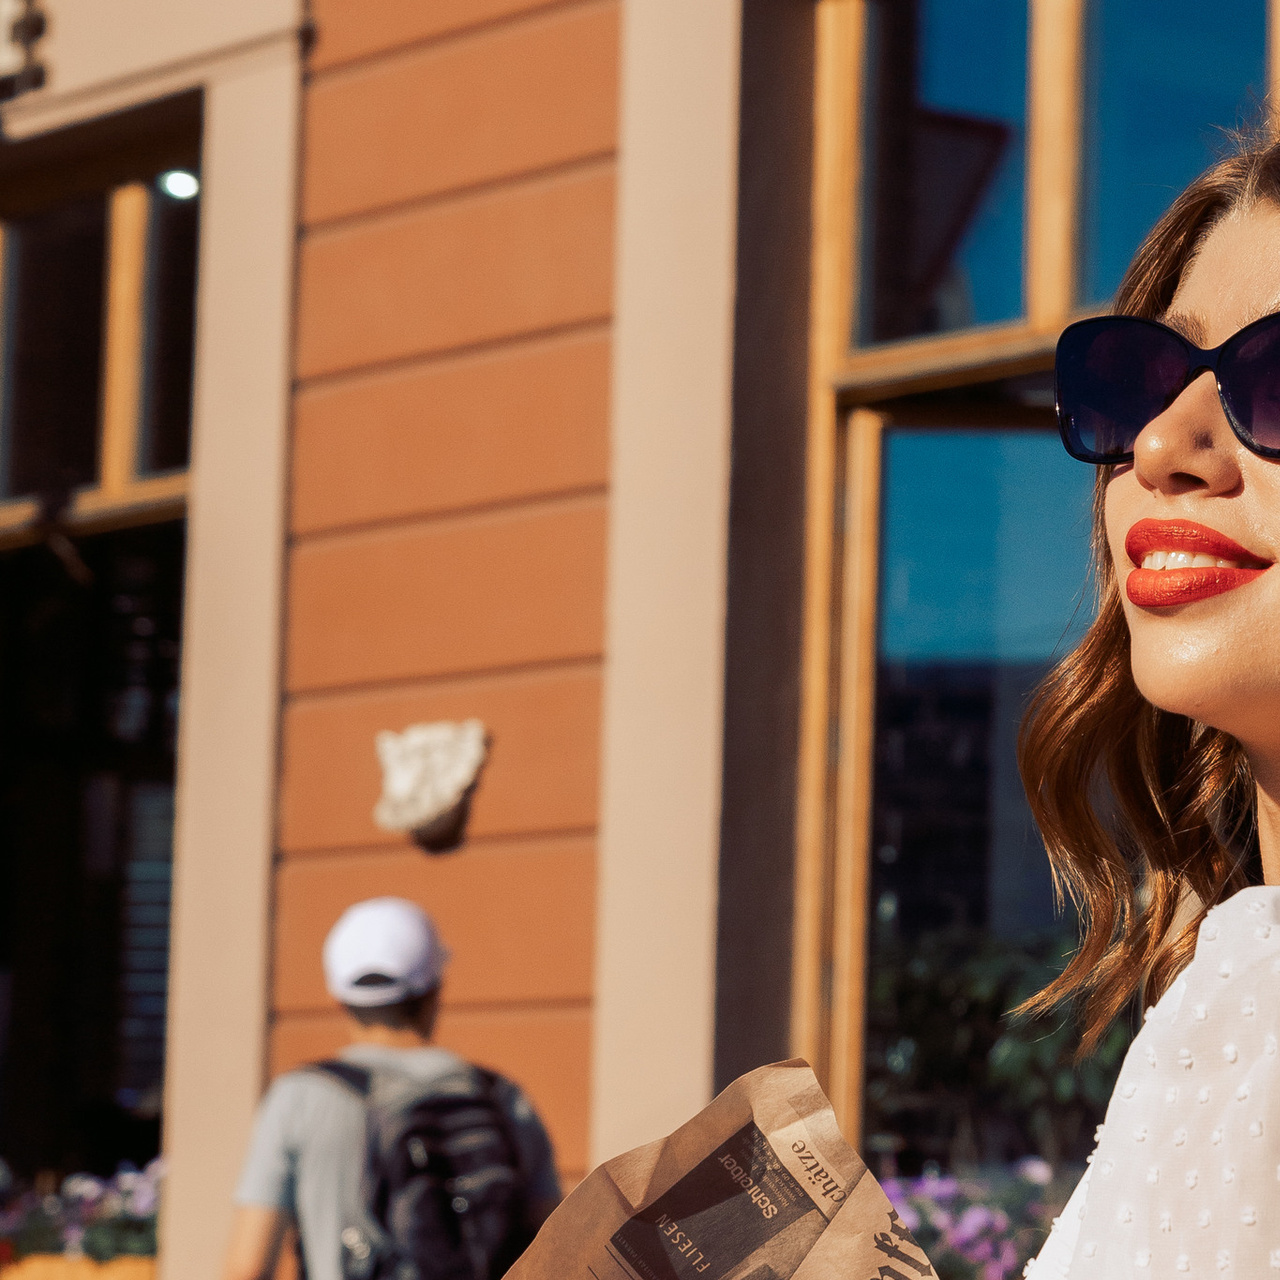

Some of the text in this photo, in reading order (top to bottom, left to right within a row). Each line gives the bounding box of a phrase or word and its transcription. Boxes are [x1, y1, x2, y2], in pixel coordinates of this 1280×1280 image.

[714, 1150, 780, 1221] Schreiber
[783, 1137, 849, 1207] chätze
[653, 1212, 711, 1273] FLIESEN
